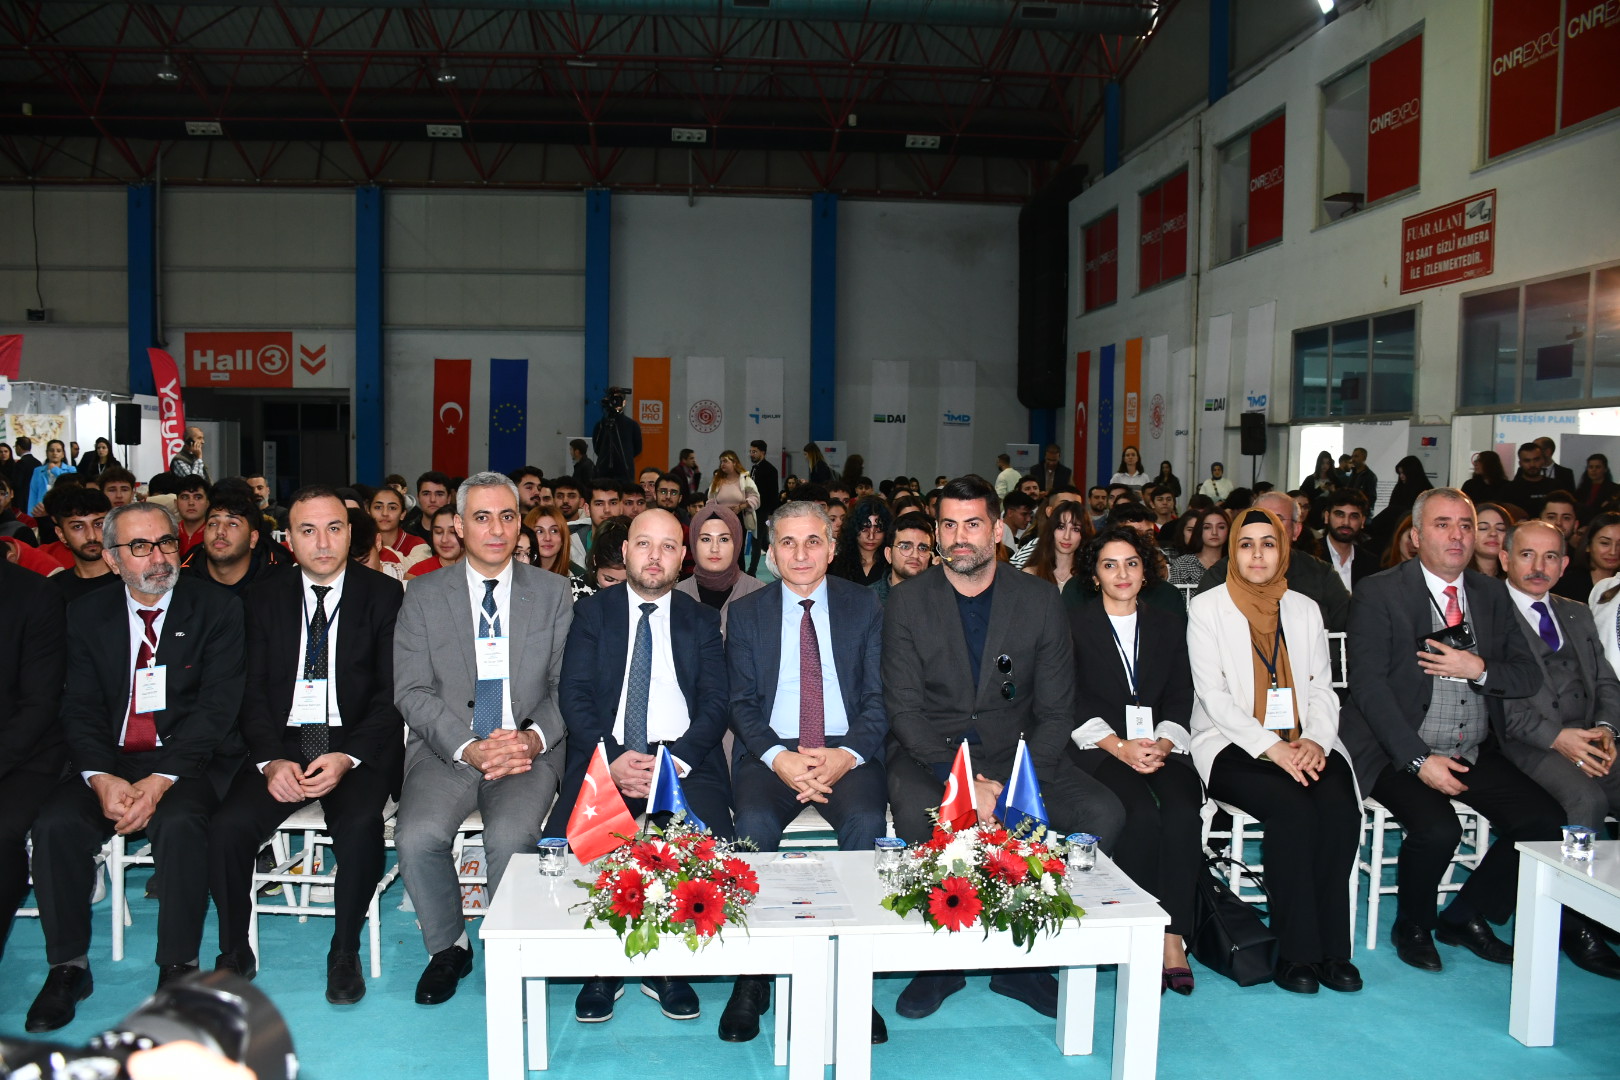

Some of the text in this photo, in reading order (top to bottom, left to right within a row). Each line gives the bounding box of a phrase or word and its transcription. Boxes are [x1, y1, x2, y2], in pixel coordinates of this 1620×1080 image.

[1370, 98, 1419, 134] CNREXPO
[1407, 213, 1462, 242] FUAR ALANI
[1405, 249, 1414, 263] 24
[1416, 246, 1433, 261] SAAT
[1457, 229, 1489, 249] KAMERA
[193, 350, 253, 371] Hall
[1213, 397, 1225, 412] DAI
[641, 413, 660, 421] PRO
[886, 414, 906, 424] DAI
[1499, 413, 1576, 424] YERLEŞİM PLANI
